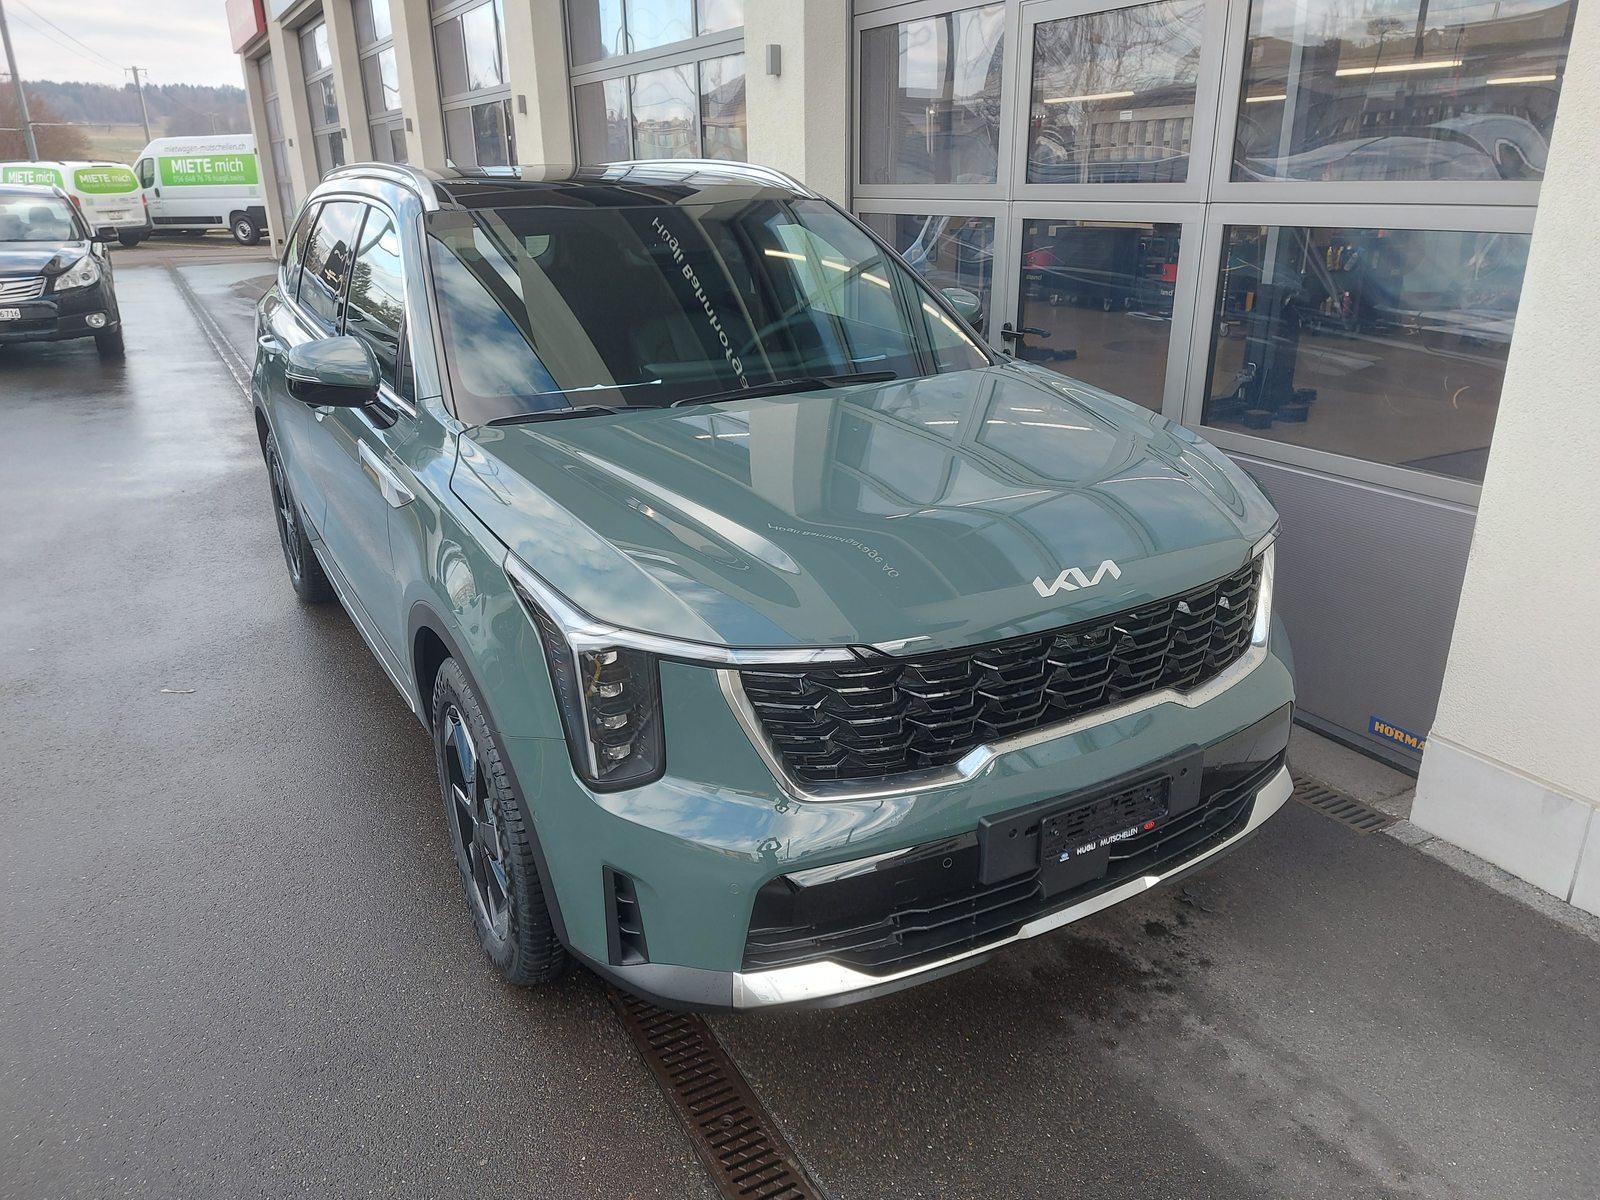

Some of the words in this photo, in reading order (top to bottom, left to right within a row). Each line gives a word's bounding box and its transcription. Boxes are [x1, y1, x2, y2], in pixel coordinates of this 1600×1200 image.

[171, 158, 212, 174] MIETE
[214, 157, 244, 173] mich
[8, 171, 35, 184] MIETE
[35, 169, 56, 183] mich
[79, 173, 111, 184] MIETE
[111, 174, 131, 183] mich
[1032, 559, 1122, 598] KIA
[1099, 826, 1139, 848] MUTSCHELLEN
